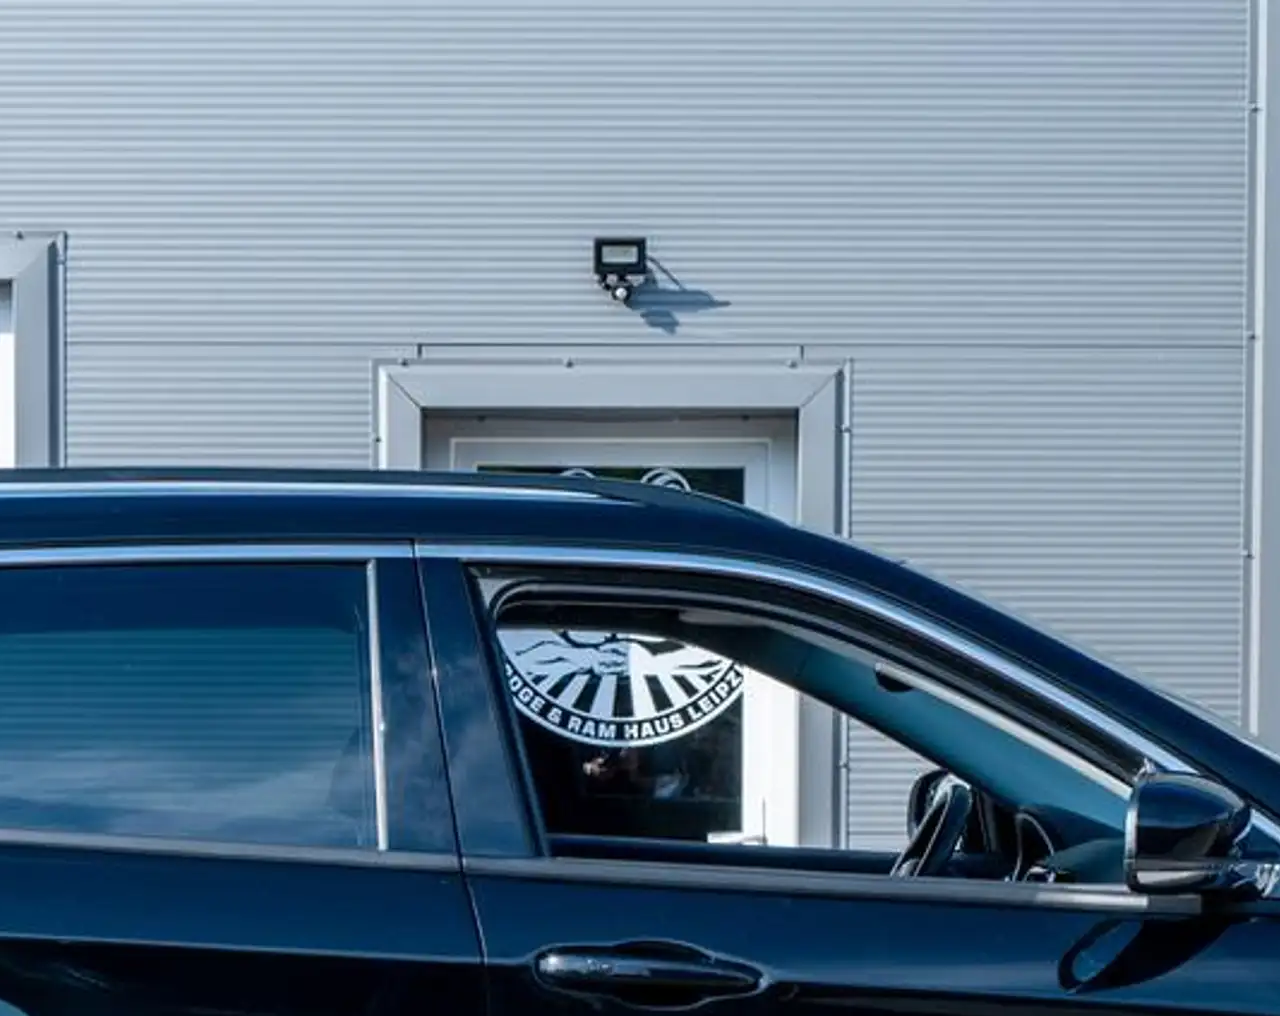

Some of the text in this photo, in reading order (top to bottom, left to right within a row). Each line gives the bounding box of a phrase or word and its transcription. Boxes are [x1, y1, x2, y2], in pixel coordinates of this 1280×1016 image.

[546, 706, 563, 725] &
[567, 715, 616, 739] RAM
[623, 713, 685, 739] HAUS
